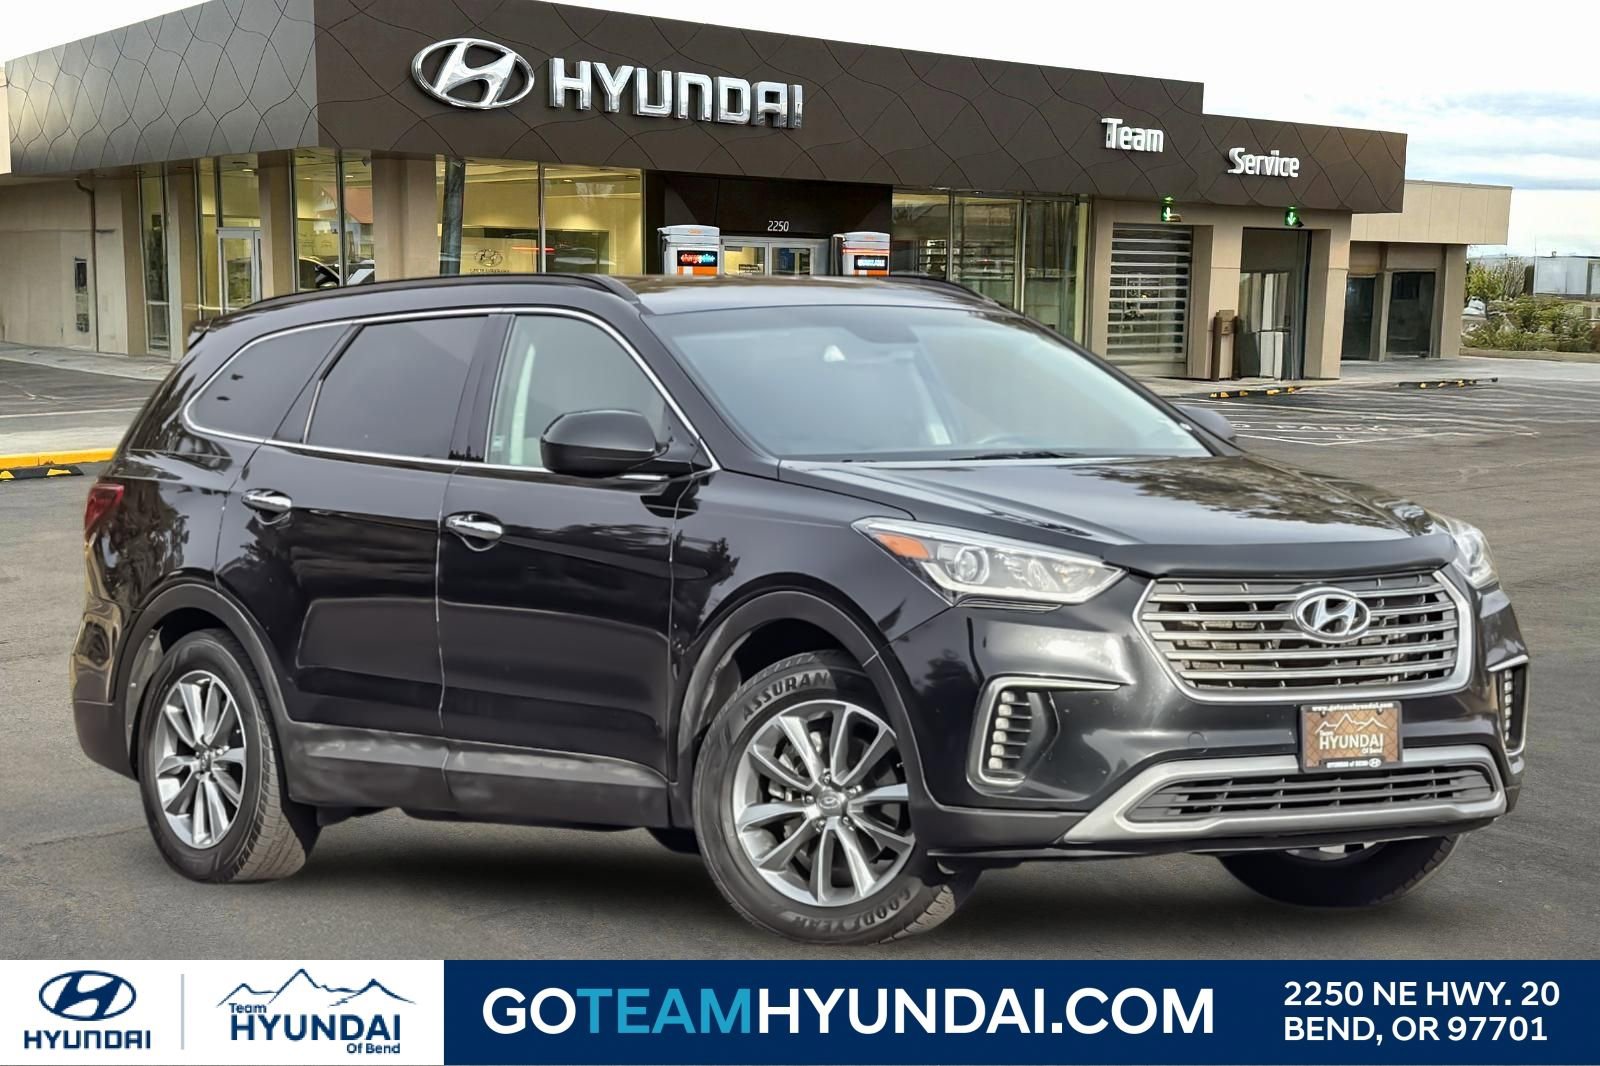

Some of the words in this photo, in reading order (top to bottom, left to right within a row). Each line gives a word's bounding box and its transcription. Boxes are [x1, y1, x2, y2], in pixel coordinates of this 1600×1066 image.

[549, 57, 803, 129] HYUNDAI
[1101, 117, 1164, 153] Team
[1227, 147, 1300, 178] Service
[767, 220, 790, 232] 2250
[1319, 734, 1384, 750] HYUNDAI
